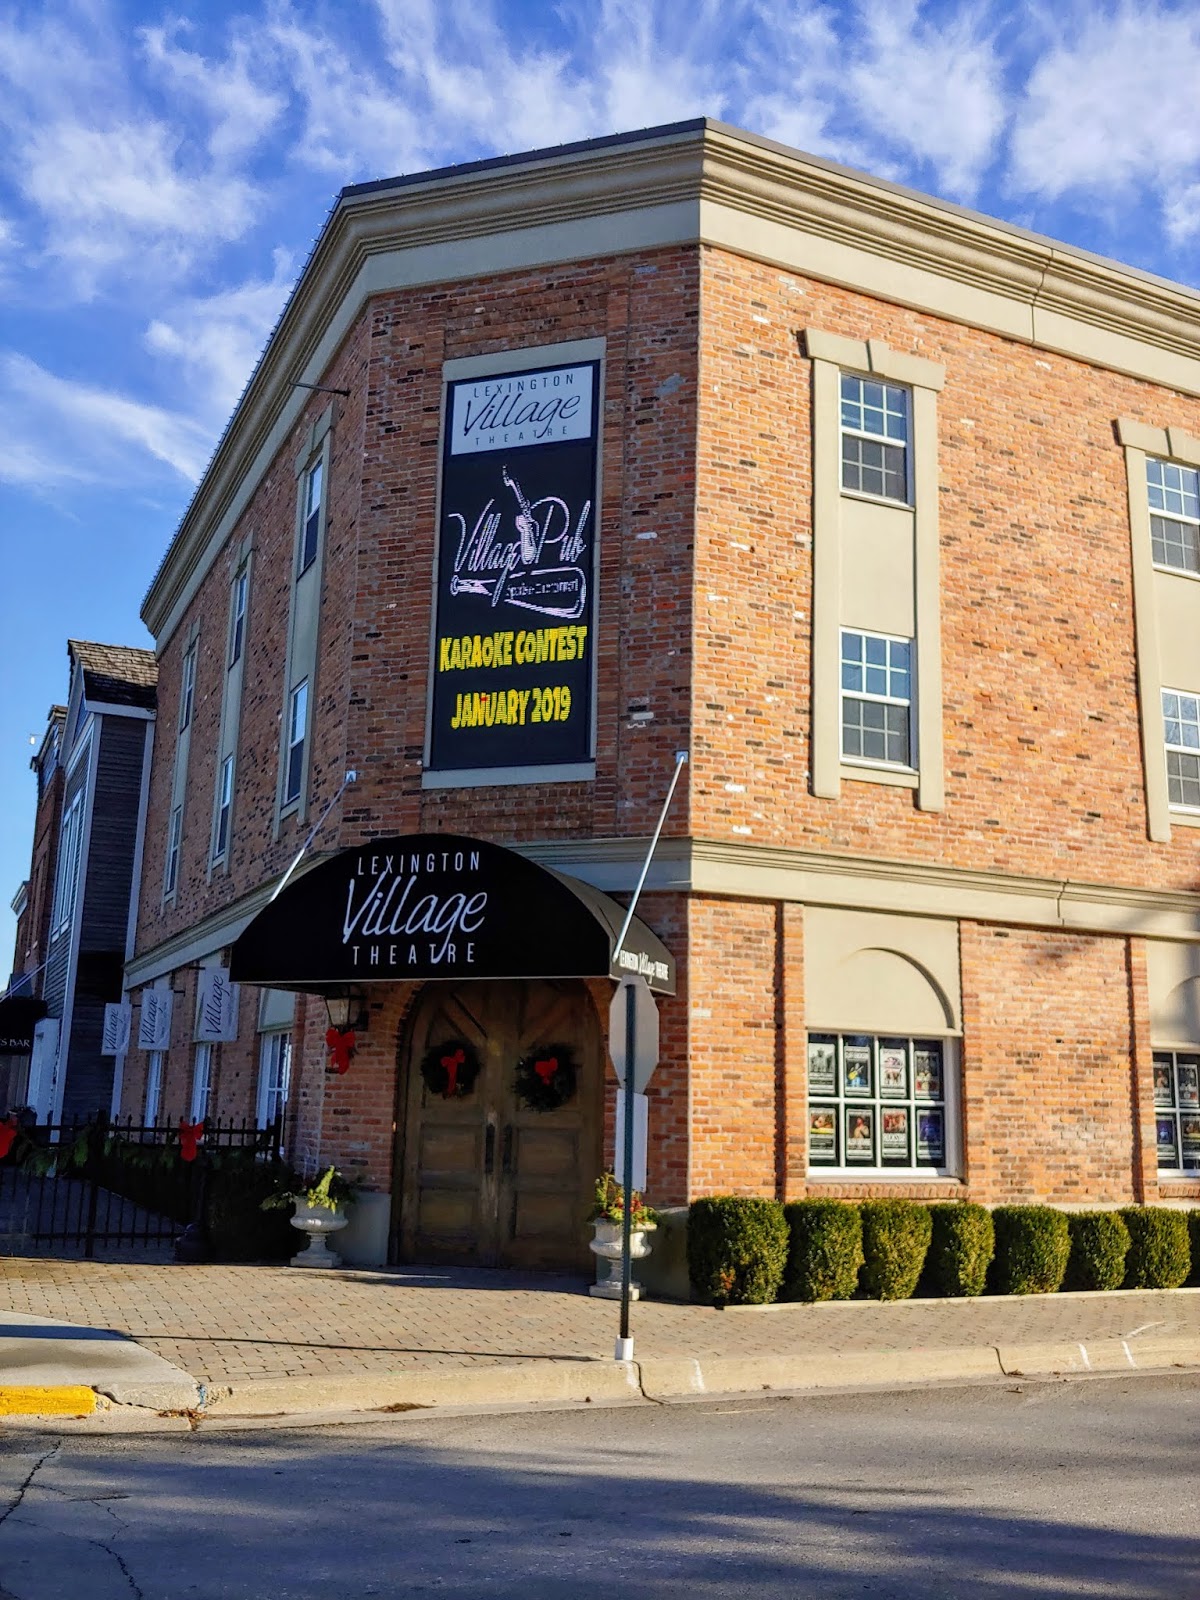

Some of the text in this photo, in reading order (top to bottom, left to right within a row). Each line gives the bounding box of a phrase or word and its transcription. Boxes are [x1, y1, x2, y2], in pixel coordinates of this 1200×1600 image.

[474, 373, 574, 398] LEXINGTON
[463, 393, 581, 439] Village
[475, 426, 568, 446] THEATRE
[440, 625, 588, 672] KARAOKE CONTEST
[451, 685, 572, 729] JANUARY 2019
[358, 851, 480, 875] LEXINGTON
[342, 871, 488, 964] Village
[353, 943, 475, 965] THEATRE
[141, 995, 163, 1044] Village
[205, 975, 230, 1034] Village
[10, 1038, 30, 1047] BAR
[104, 1008, 123, 1051] Village
